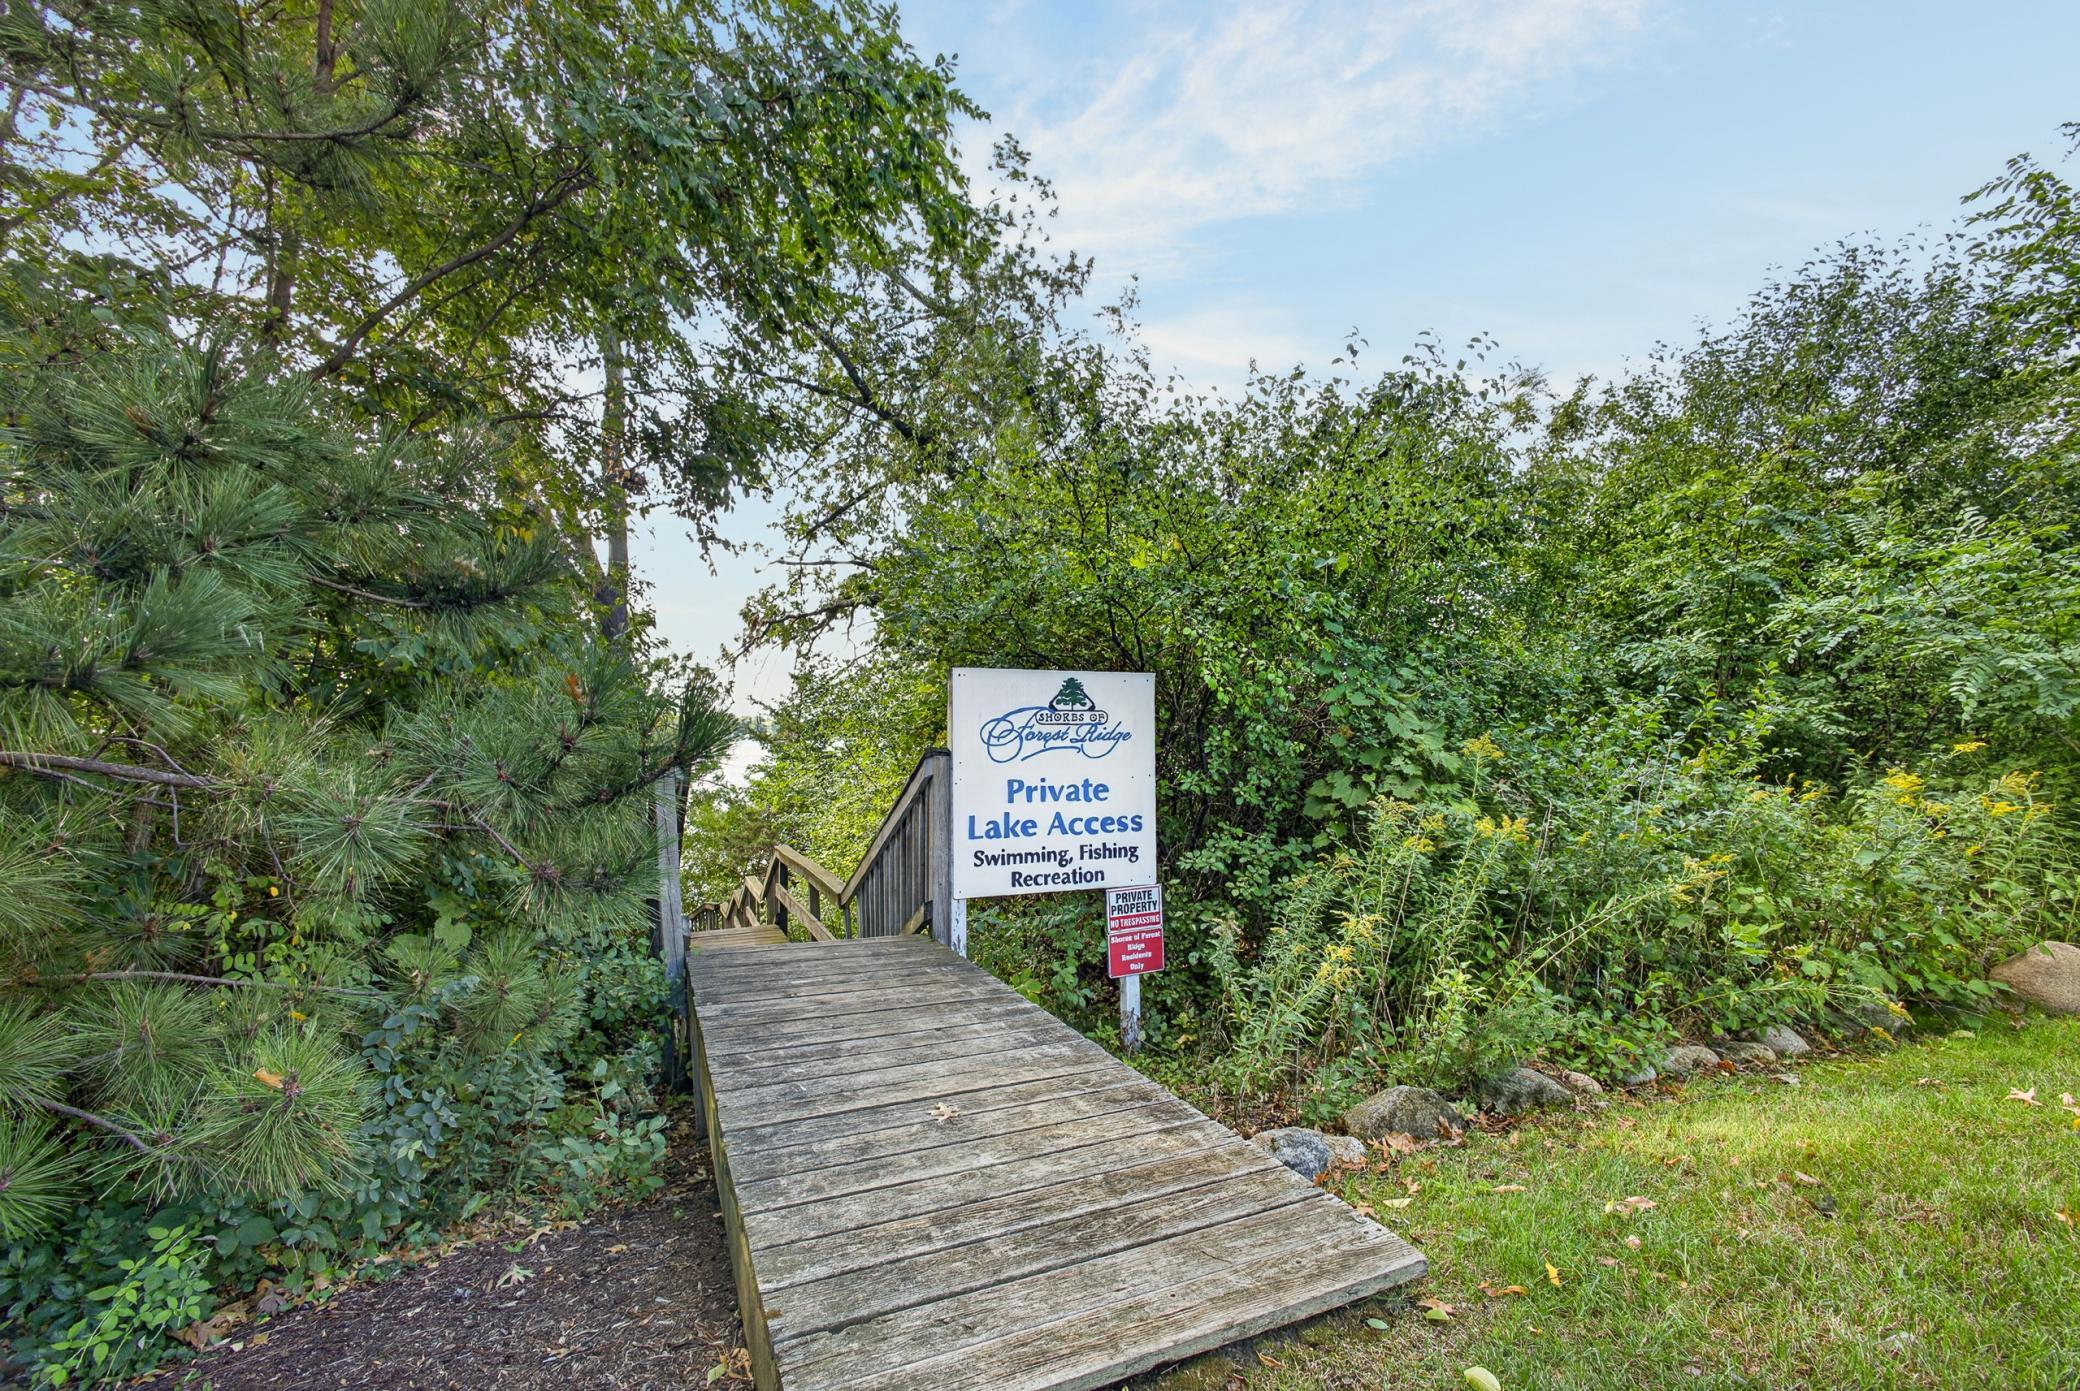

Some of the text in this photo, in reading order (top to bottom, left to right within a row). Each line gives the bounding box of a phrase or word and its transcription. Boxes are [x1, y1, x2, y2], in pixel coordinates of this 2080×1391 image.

[1038, 713, 1106, 723] SHORES OF
[1069, 721, 1132, 759] Ridge
[1007, 777, 1110, 804] Private
[968, 811, 1143, 840] Lake Access
[973, 842, 1139, 868] Swimming, Fishing
[1011, 867, 1105, 888] Recreation
[1115, 889, 1153, 904] PRIVATE
[1111, 900, 1158, 916] PROPERTY
[1110, 914, 1160, 929] NO TRESPASSING
[1111, 934, 1133, 944] Shores
[1133, 932, 1140, 942] of
[1130, 962, 1145, 971] Only
